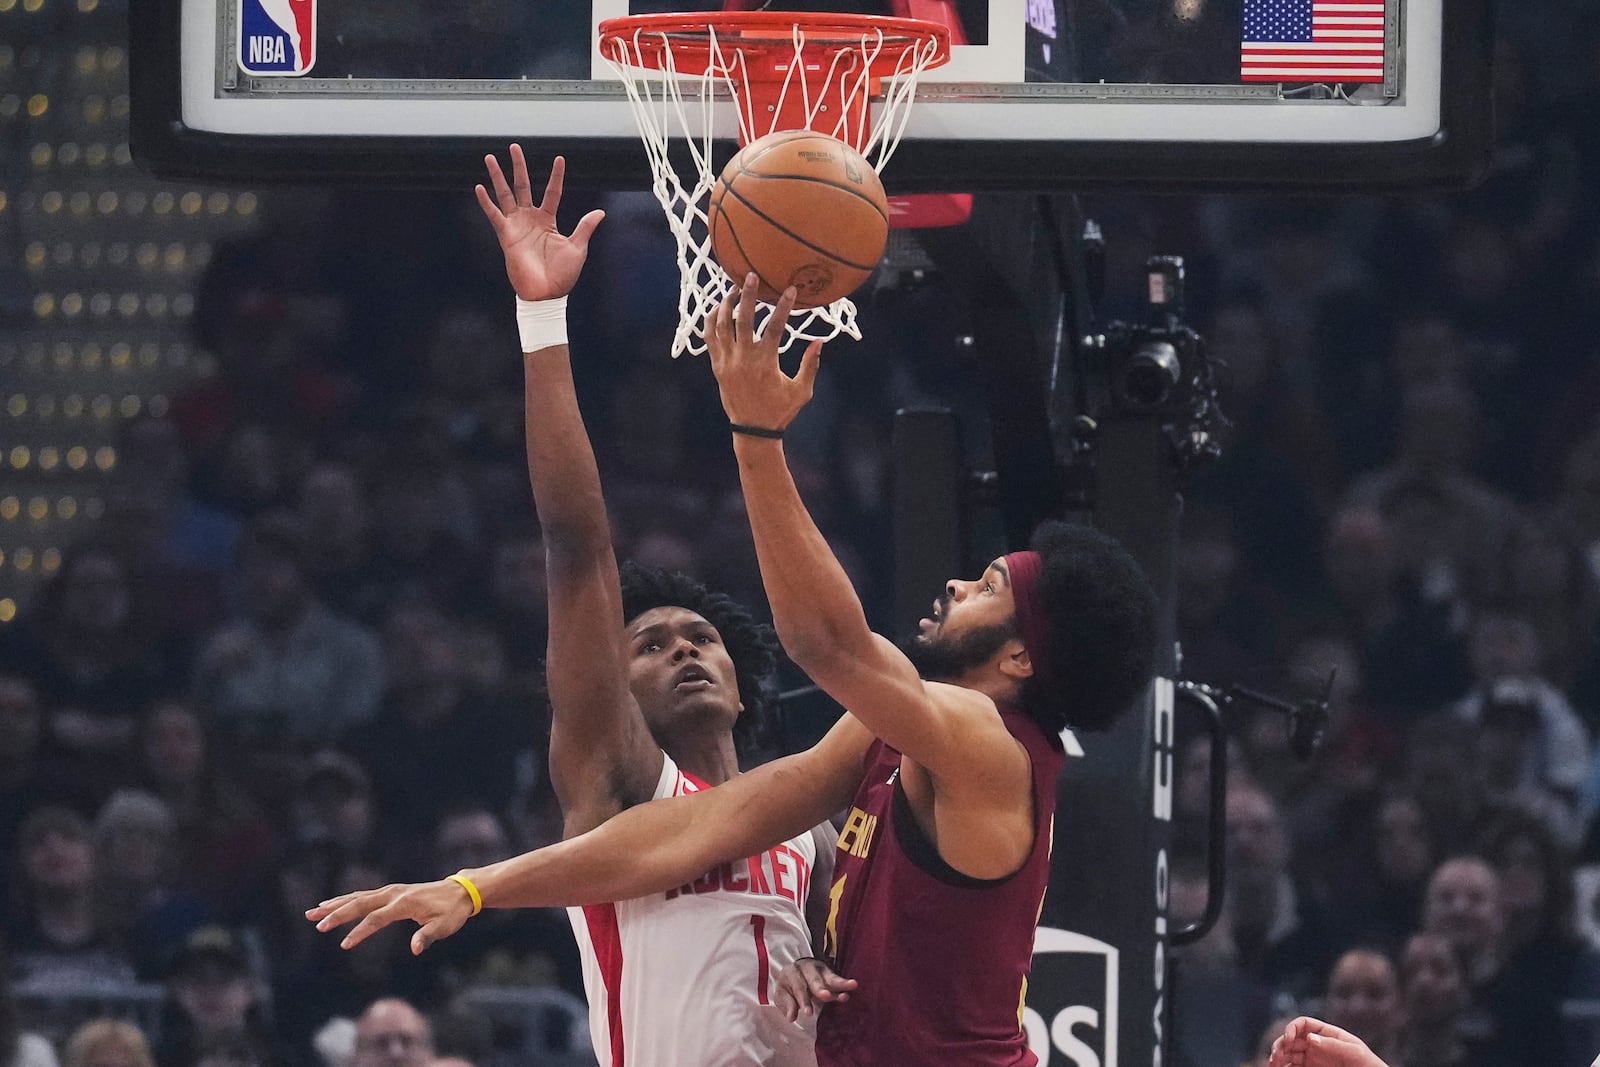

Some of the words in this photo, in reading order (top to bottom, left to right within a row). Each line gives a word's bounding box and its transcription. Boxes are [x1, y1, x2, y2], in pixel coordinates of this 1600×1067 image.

[249, 35, 286, 64] NBA
[665, 843, 811, 909] OCKET
[750, 914, 771, 1005] 1
